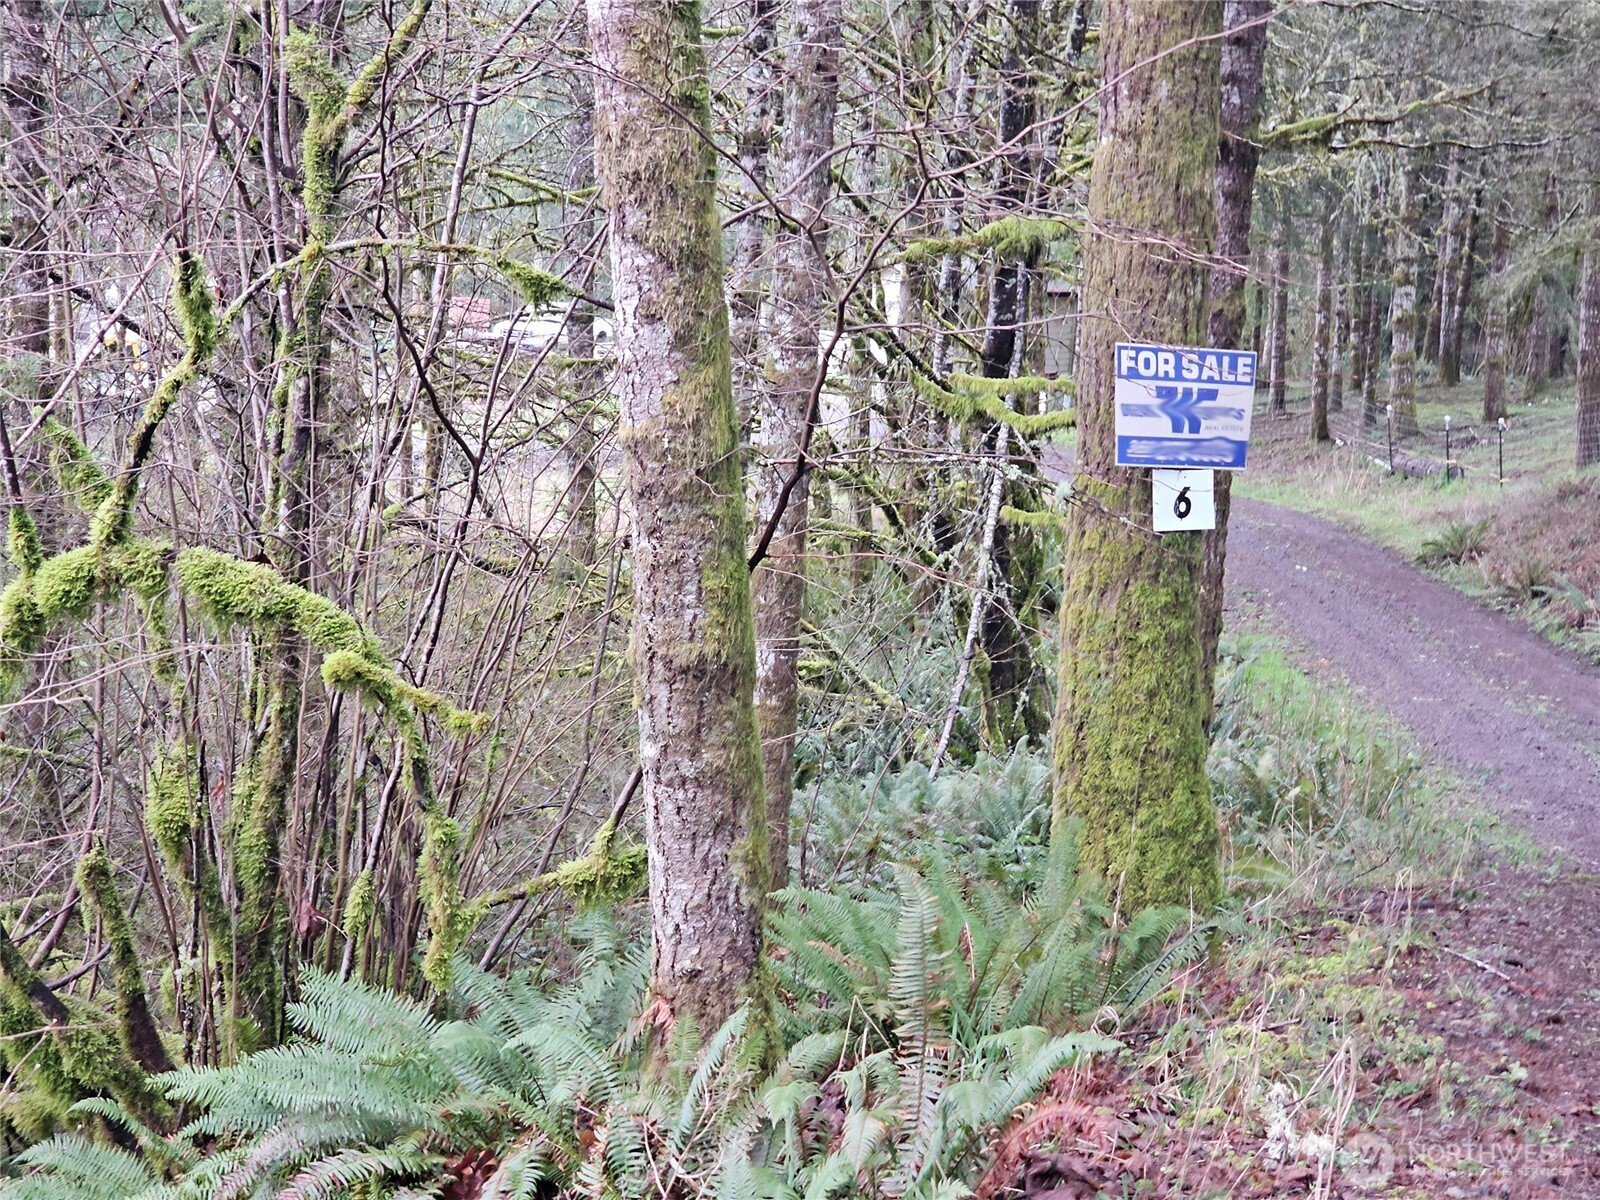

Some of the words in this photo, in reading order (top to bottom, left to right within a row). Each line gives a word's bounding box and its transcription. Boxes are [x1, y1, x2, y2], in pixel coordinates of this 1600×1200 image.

[1121, 349, 1175, 378] FOR
[1182, 353, 1253, 382] SALE
[1221, 425, 1244, 433] ESTATE
[1173, 486, 1191, 519] 6
